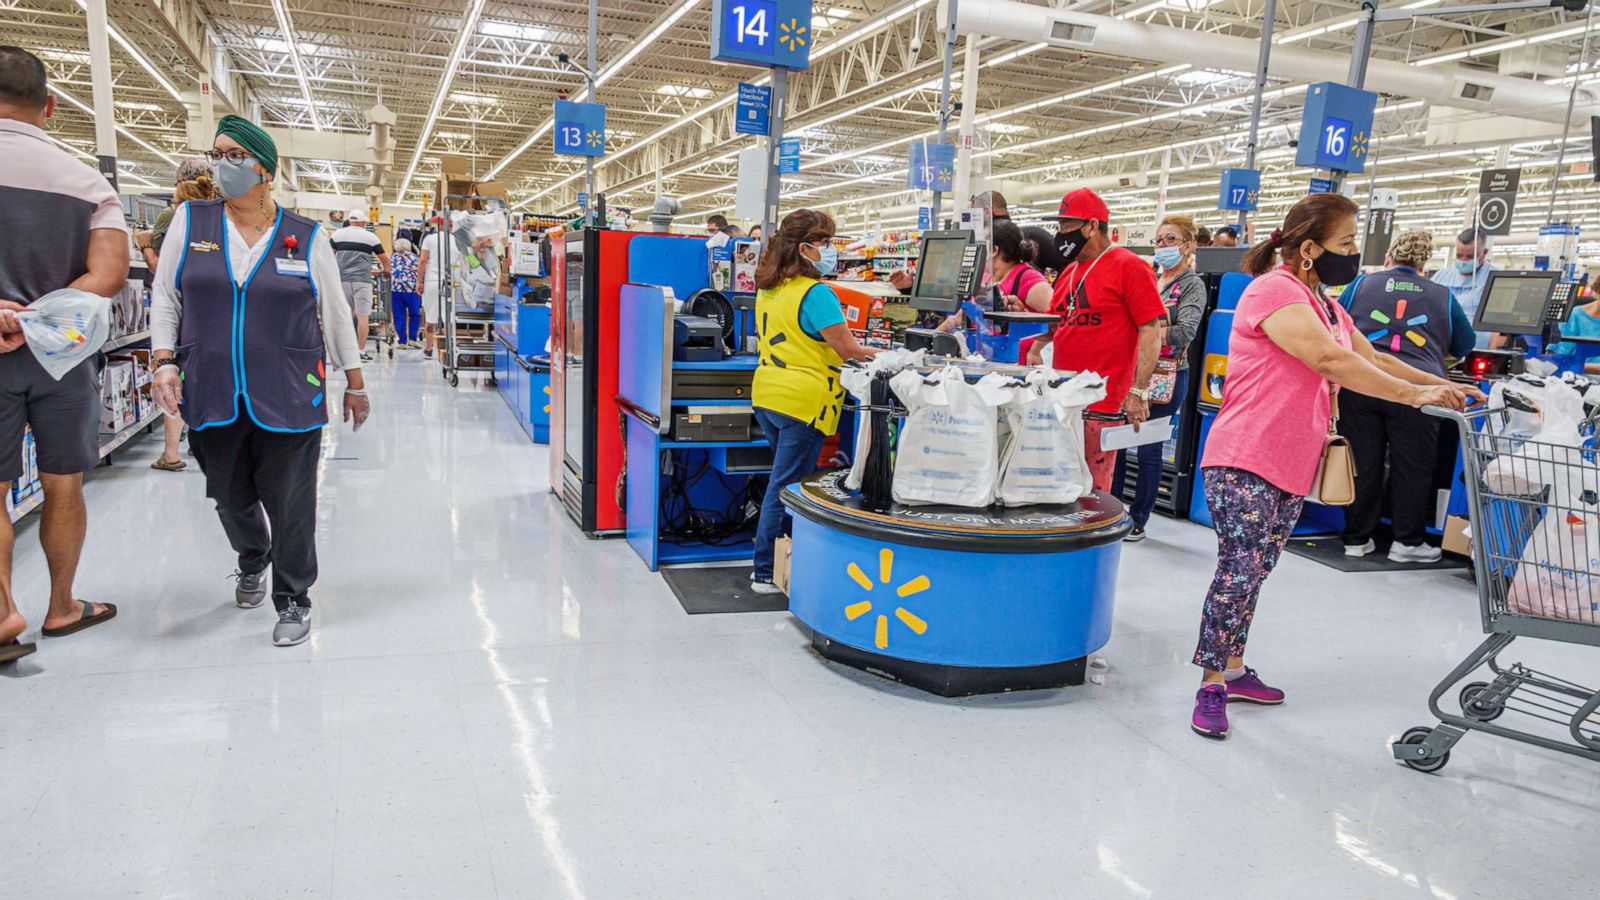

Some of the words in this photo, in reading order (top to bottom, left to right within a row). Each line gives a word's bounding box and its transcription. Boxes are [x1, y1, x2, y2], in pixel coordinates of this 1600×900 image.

[733, 6, 769, 46] 14
[561, 127, 582, 147] 13
[1326, 125, 1346, 156] 16
[920, 165, 935, 183] 15
[1489, 180, 1510, 188] Jewelry
[1232, 189, 1246, 204] 17
[892, 509, 945, 520] JUST
[952, 516, 1005, 524] ONE
[1009, 515, 1070, 525] MORE
